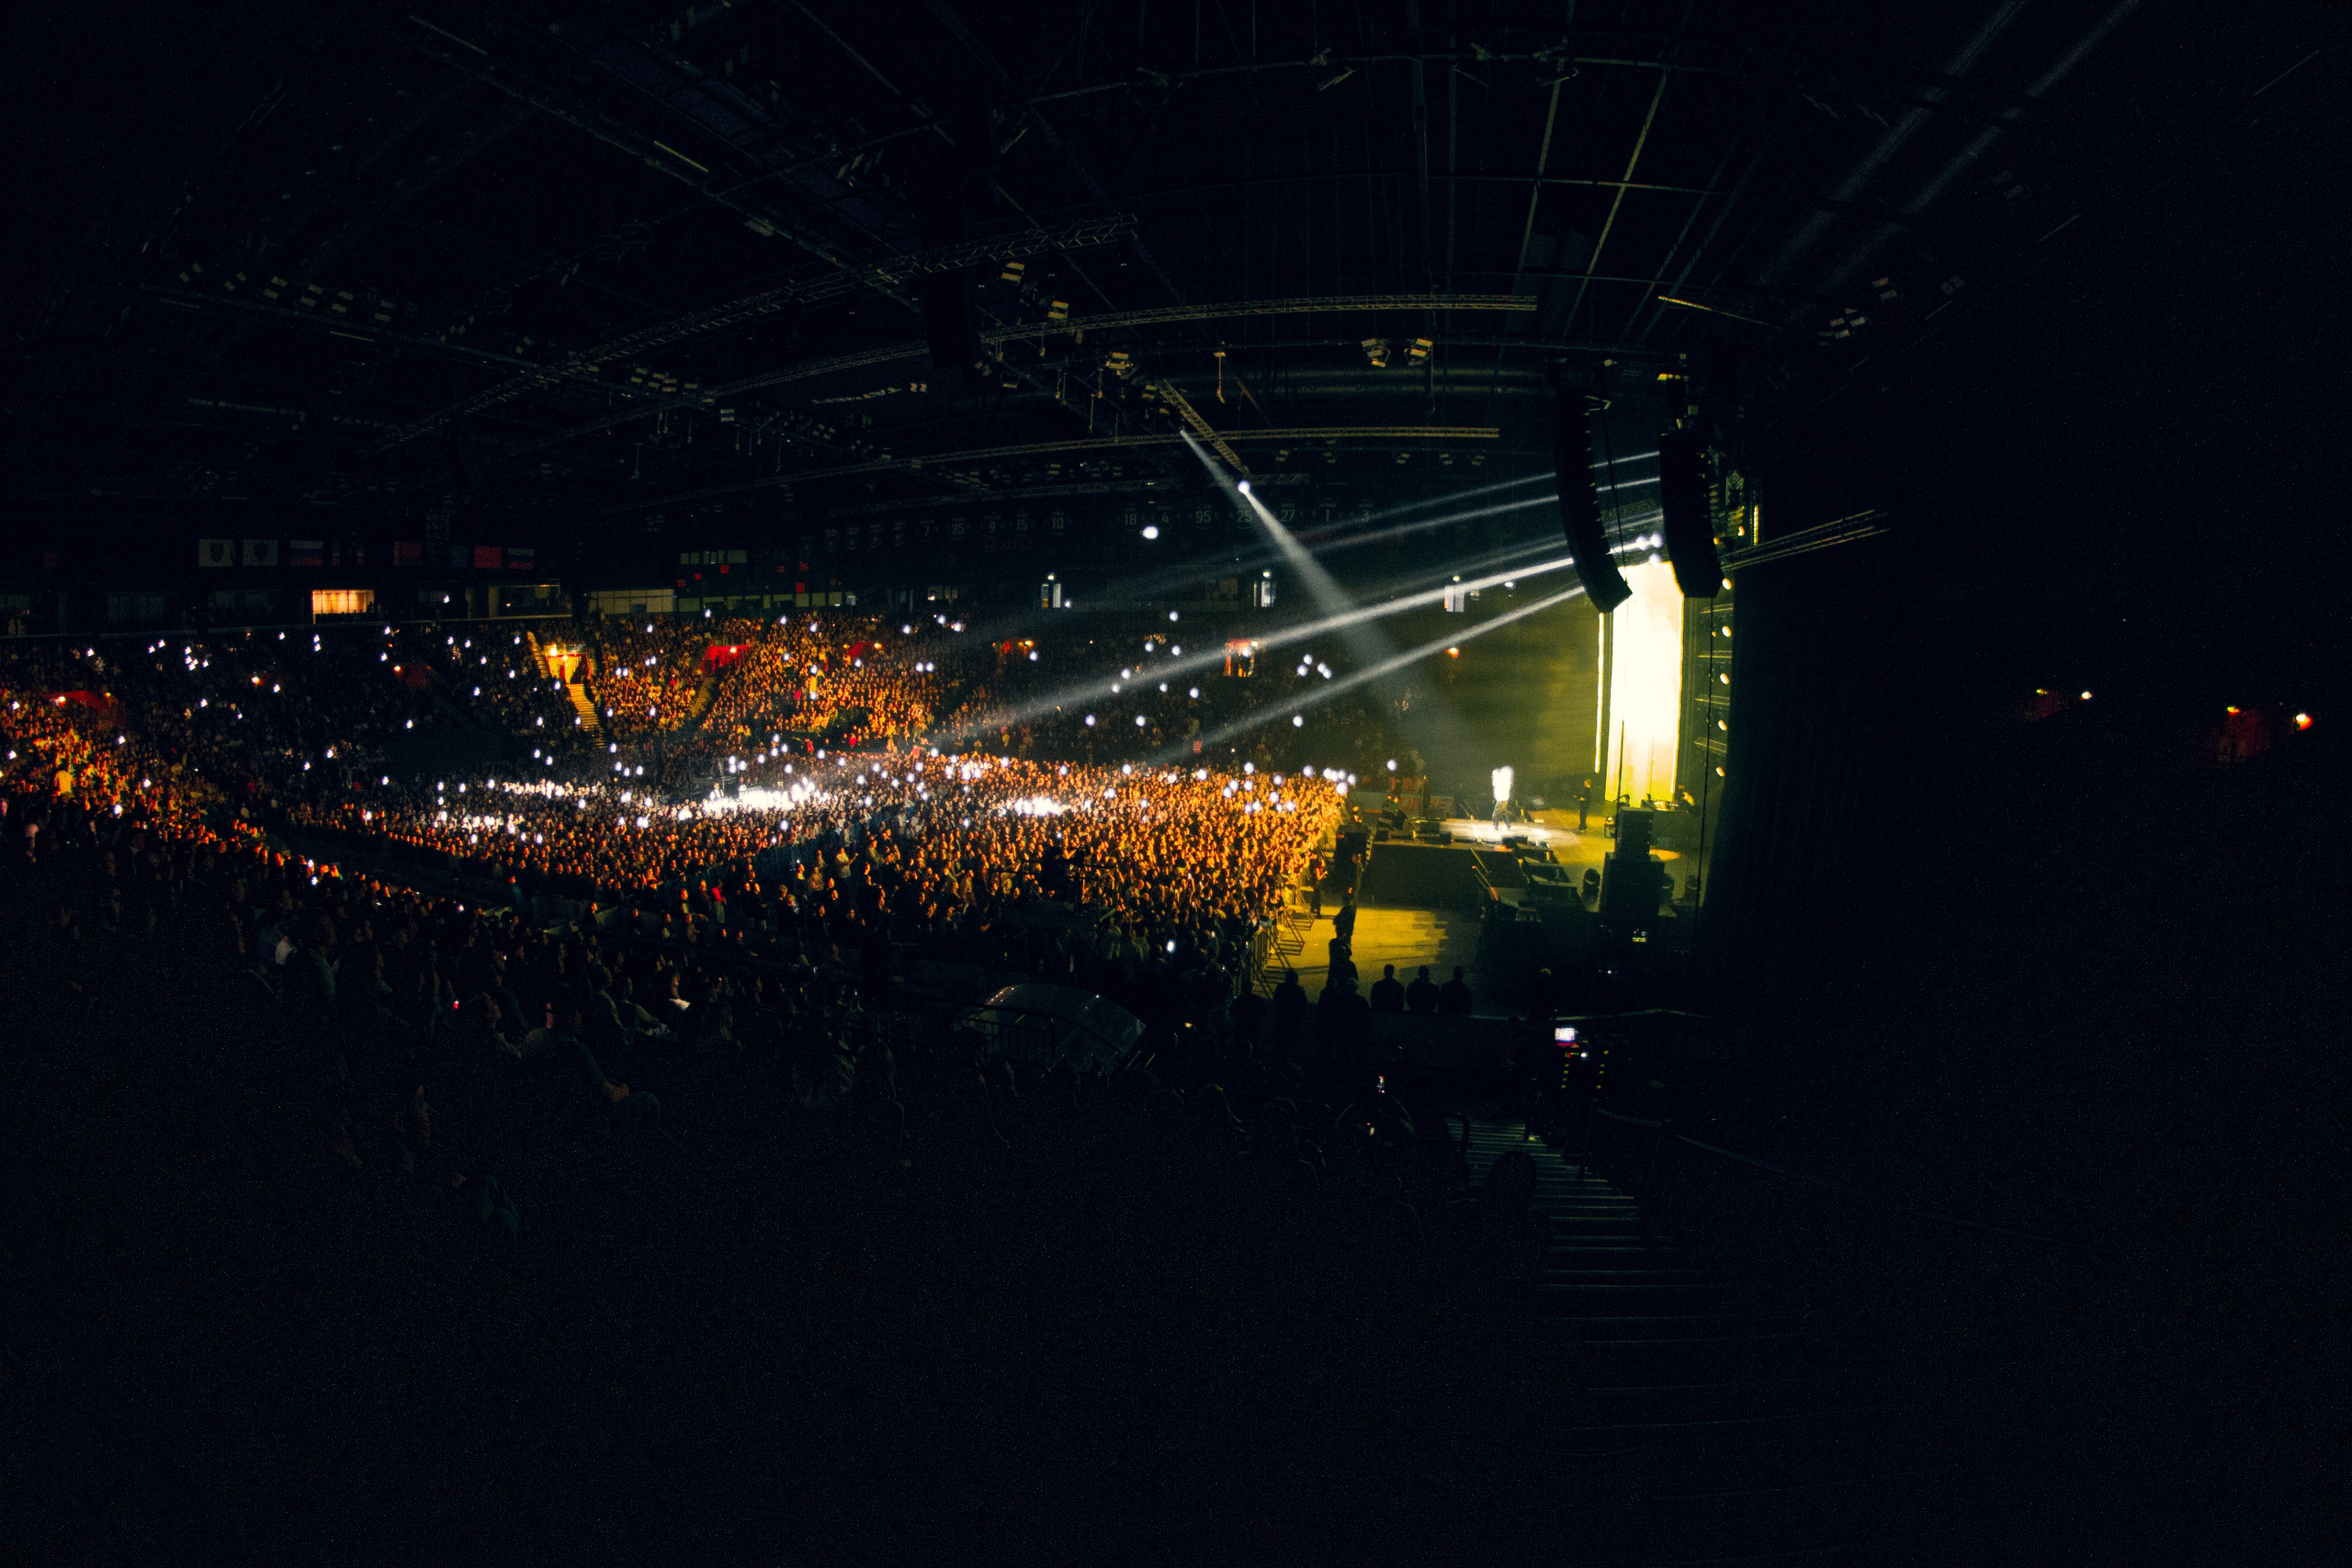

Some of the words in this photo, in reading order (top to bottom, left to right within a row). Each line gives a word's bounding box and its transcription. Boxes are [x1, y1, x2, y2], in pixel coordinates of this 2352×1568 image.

[1125, 513, 1137, 526] 18
[1161, 512, 1170, 525] 4
[1195, 510, 1212, 524] 95
[1237, 509, 1252, 523] 25
[1280, 509, 1295, 523] 27
[1362, 510, 1370, 523] 3
[951, 522, 965, 536] 25
[989, 520, 996, 534] 9
[1016, 518, 1028, 531] 15
[1052, 517, 1064, 530] 10
[923, 525, 931, 536] 7
